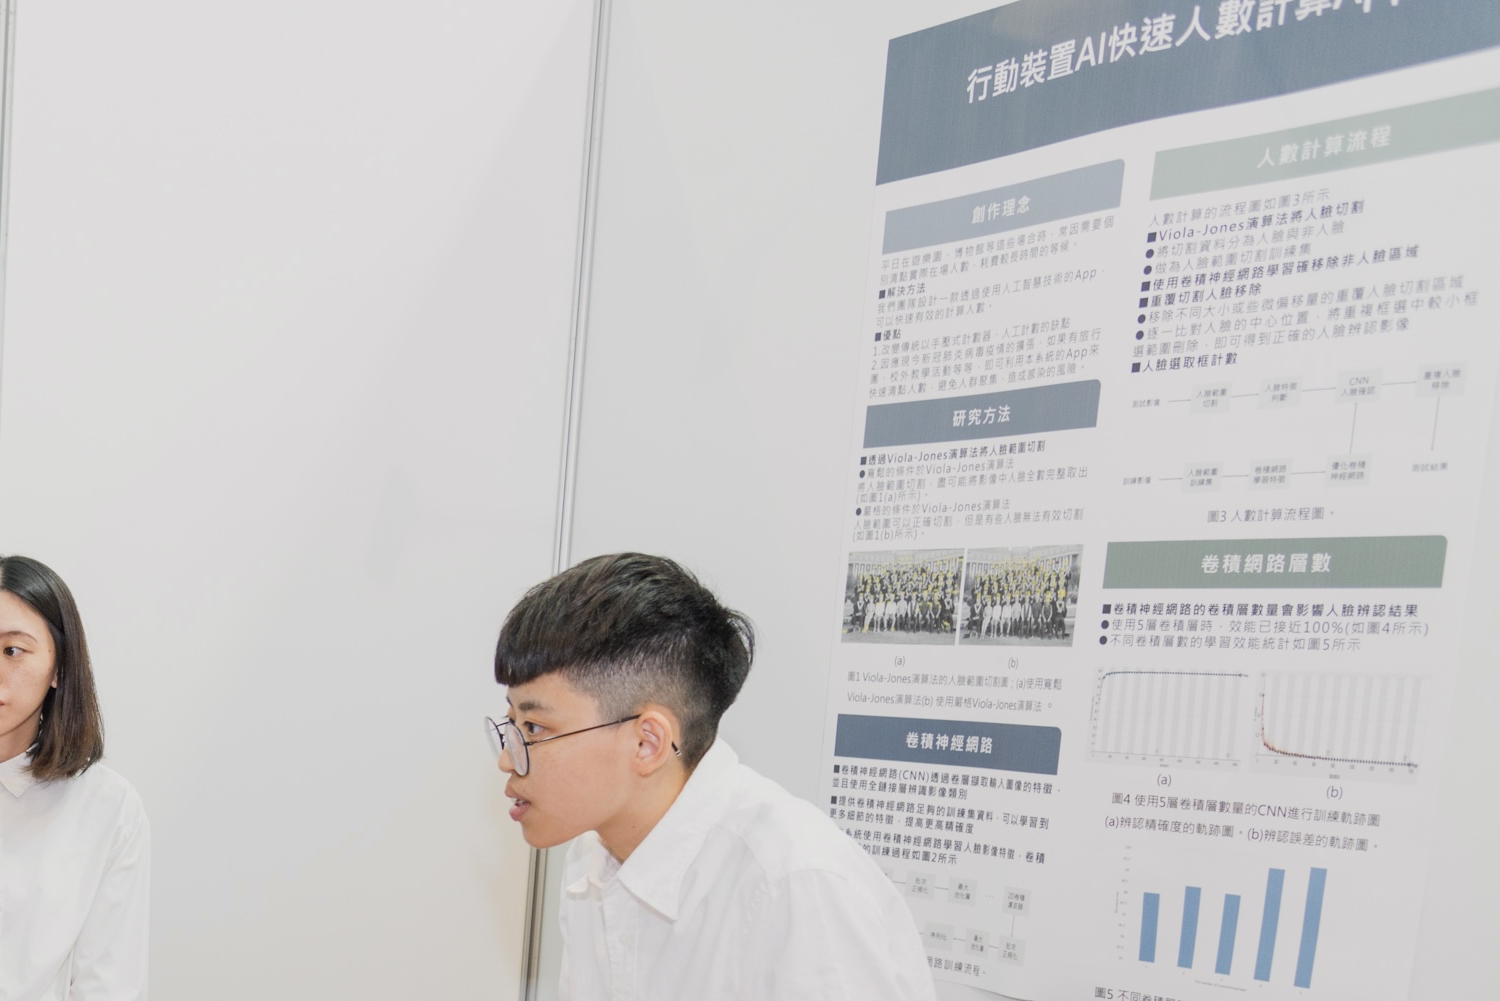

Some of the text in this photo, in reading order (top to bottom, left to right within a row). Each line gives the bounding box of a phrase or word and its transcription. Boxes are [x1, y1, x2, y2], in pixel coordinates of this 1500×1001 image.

[966, 0, 1399, 104] 行動裝置AI快速人數計算
[1257, 125, 1392, 170] 人數計算流程
[972, 195, 1031, 225] 創作理念
[1159, 200, 1364, 242] Viola-Jones演算法將人臉切割
[887, 282, 926, 299] 解決方法
[883, 328, 902, 342] 優點
[1142, 351, 1238, 373] 人臉選取框計數
[952, 404, 1011, 427] 研究方法
[1201, 553, 1331, 574] 卷積網路層數
[1113, 603, 1419, 618] 卷積神經網路的卷積層數量會影響人臉辨認結果
[894, 656, 906, 668] (a)
[1008, 656, 1019, 670] (b)
[905, 732, 994, 755] 卷積神經網路
[1156, 773, 1173, 787] (a)
[1325, 785, 1344, 800] (b)
